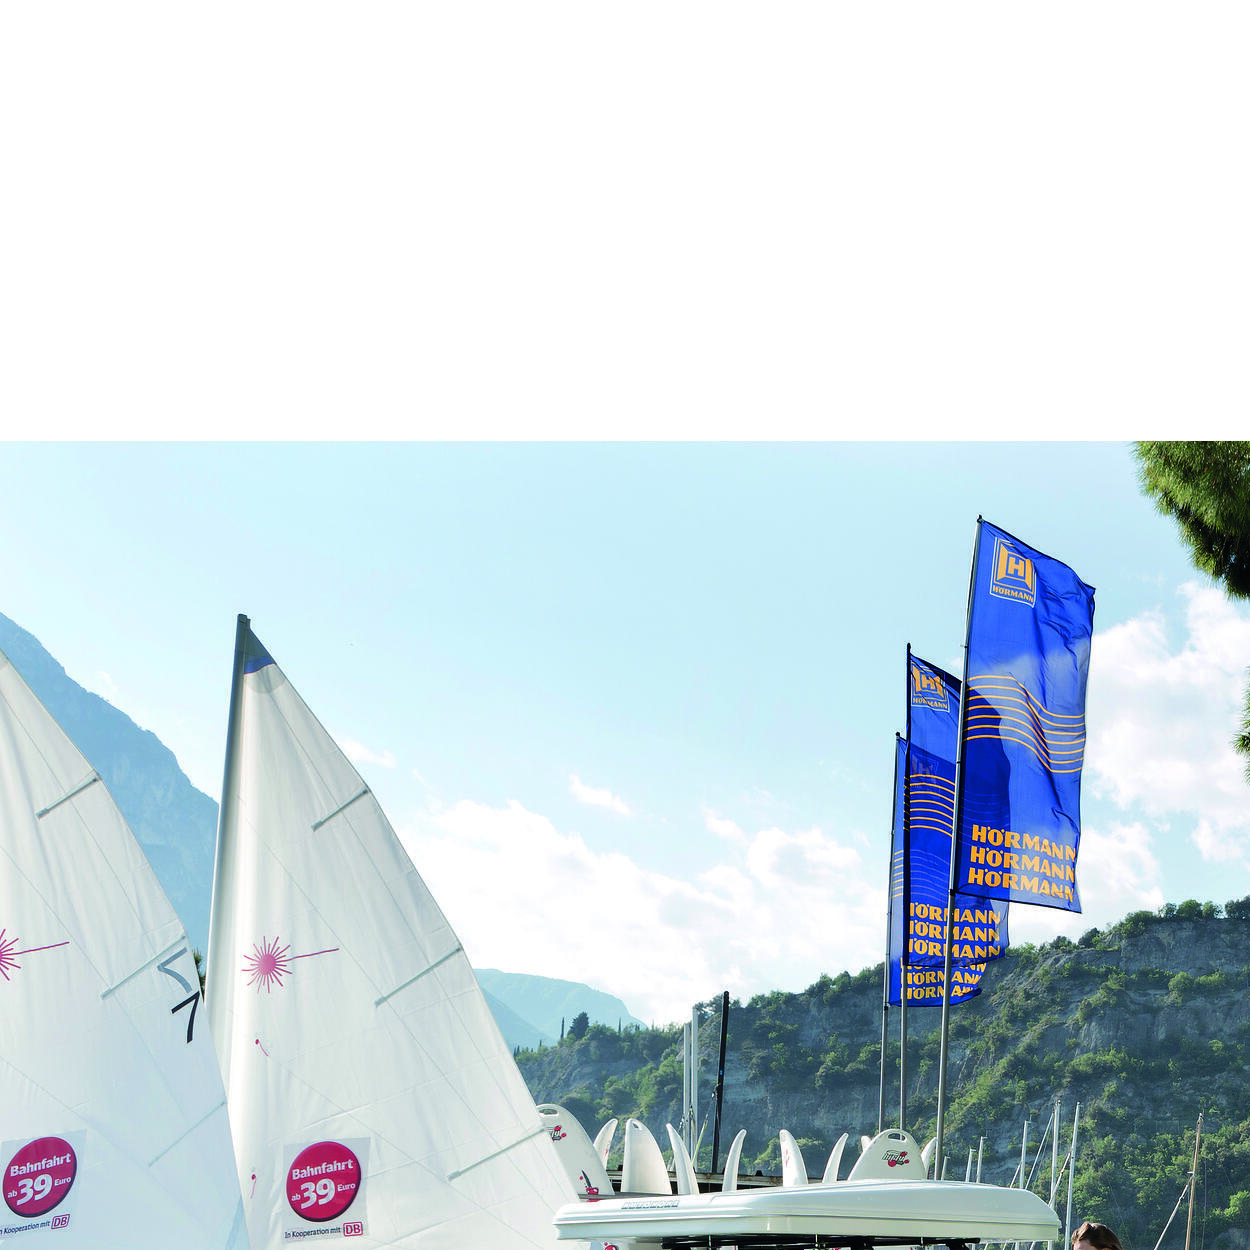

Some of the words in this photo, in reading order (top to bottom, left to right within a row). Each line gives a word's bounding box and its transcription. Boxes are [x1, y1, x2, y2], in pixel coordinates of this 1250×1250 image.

[972, 824, 1076, 862] HÖRMANN
[970, 845, 1075, 883] HÖRMANN
[968, 867, 1074, 903] HÖRMANN
[10, 1153, 71, 1177] Bahnfahrt
[292, 1159, 353, 1180] Bahnfahrt
[7, 1190, 18, 1199] ab
[16, 1173, 53, 1206] 39
[54, 1177, 72, 1186] Euro
[291, 1193, 301, 1202] ab
[300, 1178, 336, 1209] 39
[337, 1183, 356, 1191] Euro
[3, 1222, 40, 1235] Kooperation
[39, 1220, 51, 1228] mit
[53, 1216, 68, 1228] DB
[291, 1229, 330, 1239] Kooperation
[329, 1226, 342, 1234] mit
[345, 1224, 361, 1234] DB
